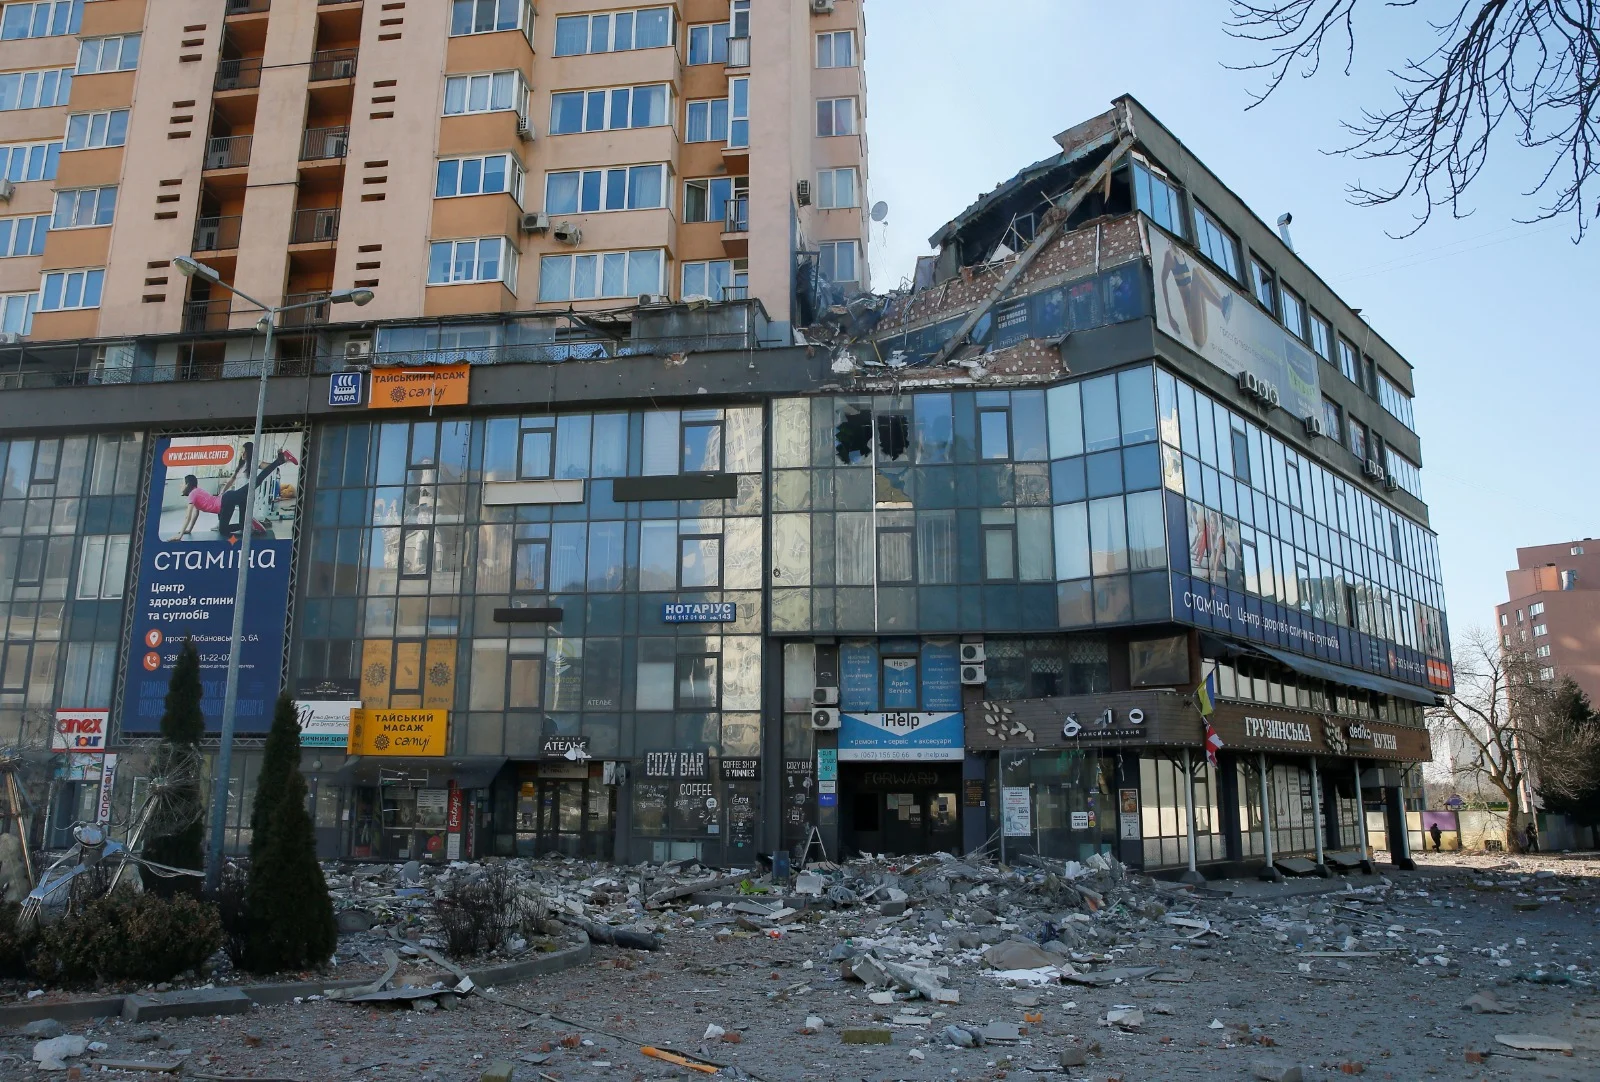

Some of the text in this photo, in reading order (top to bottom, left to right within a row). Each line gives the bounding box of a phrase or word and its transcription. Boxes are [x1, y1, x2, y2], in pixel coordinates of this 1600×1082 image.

[374, 372, 466, 384] ТАЙСЬКИЙ МАСАЖ
[168, 450, 229, 461] WWW.STAMINA.CENTER
[151, 582, 185, 595] Центр
[149, 596, 234, 609] здоров'я спини
[665, 603, 731, 614] НОТАРІУС
[148, 610, 210, 622] та суглобів
[1237, 606, 1260, 628] Центр
[375, 713, 434, 722] ТАЙСЬКИЙ
[881, 712, 920, 729] iHelp
[57, 718, 103, 734] anex
[383, 724, 424, 732] МАСАЖ
[1244, 716, 1312, 742] ГРУЗИНСЬКА
[75, 735, 102, 747] tour
[1373, 732, 1398, 750] КУХНЯ
[646, 752, 704, 777] COZY BAR
[722, 760, 757, 769] COFFEE SHOP
[786, 761, 801, 769] COZY
[680, 783, 712, 796] COFFEE
